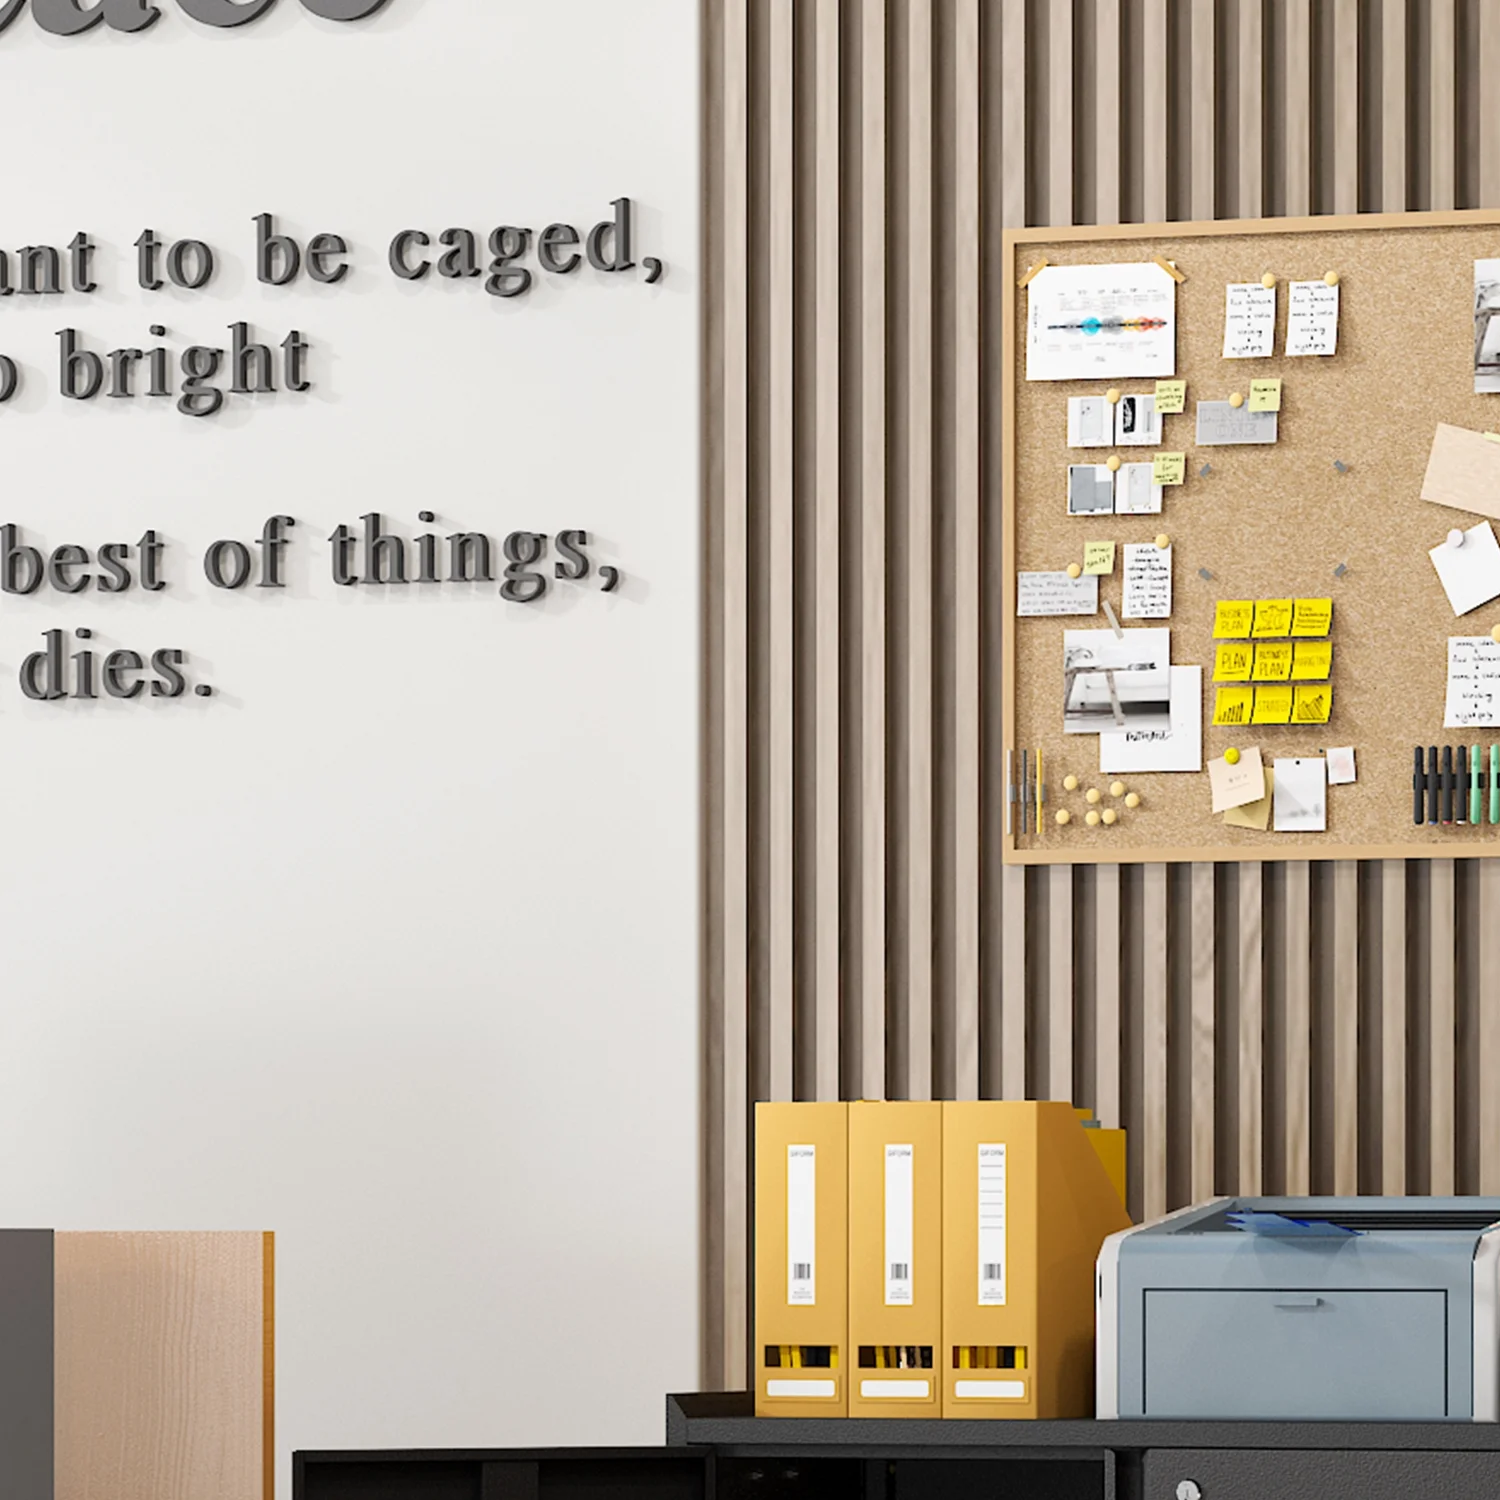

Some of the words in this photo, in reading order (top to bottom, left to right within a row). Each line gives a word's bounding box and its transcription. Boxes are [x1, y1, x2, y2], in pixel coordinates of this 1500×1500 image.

[134, 229, 214, 291] to
[252, 213, 349, 286] be
[389, 197, 663, 298] caged,
[55, 322, 311, 417] bright
[0, 523, 167, 595] best
[204, 515, 296, 590] of
[328, 511, 619, 603] things,
[20, 628, 213, 701] dies.
[1221, 651, 1247, 670] PLAN
[1258, 661, 1285, 676] PLAN
